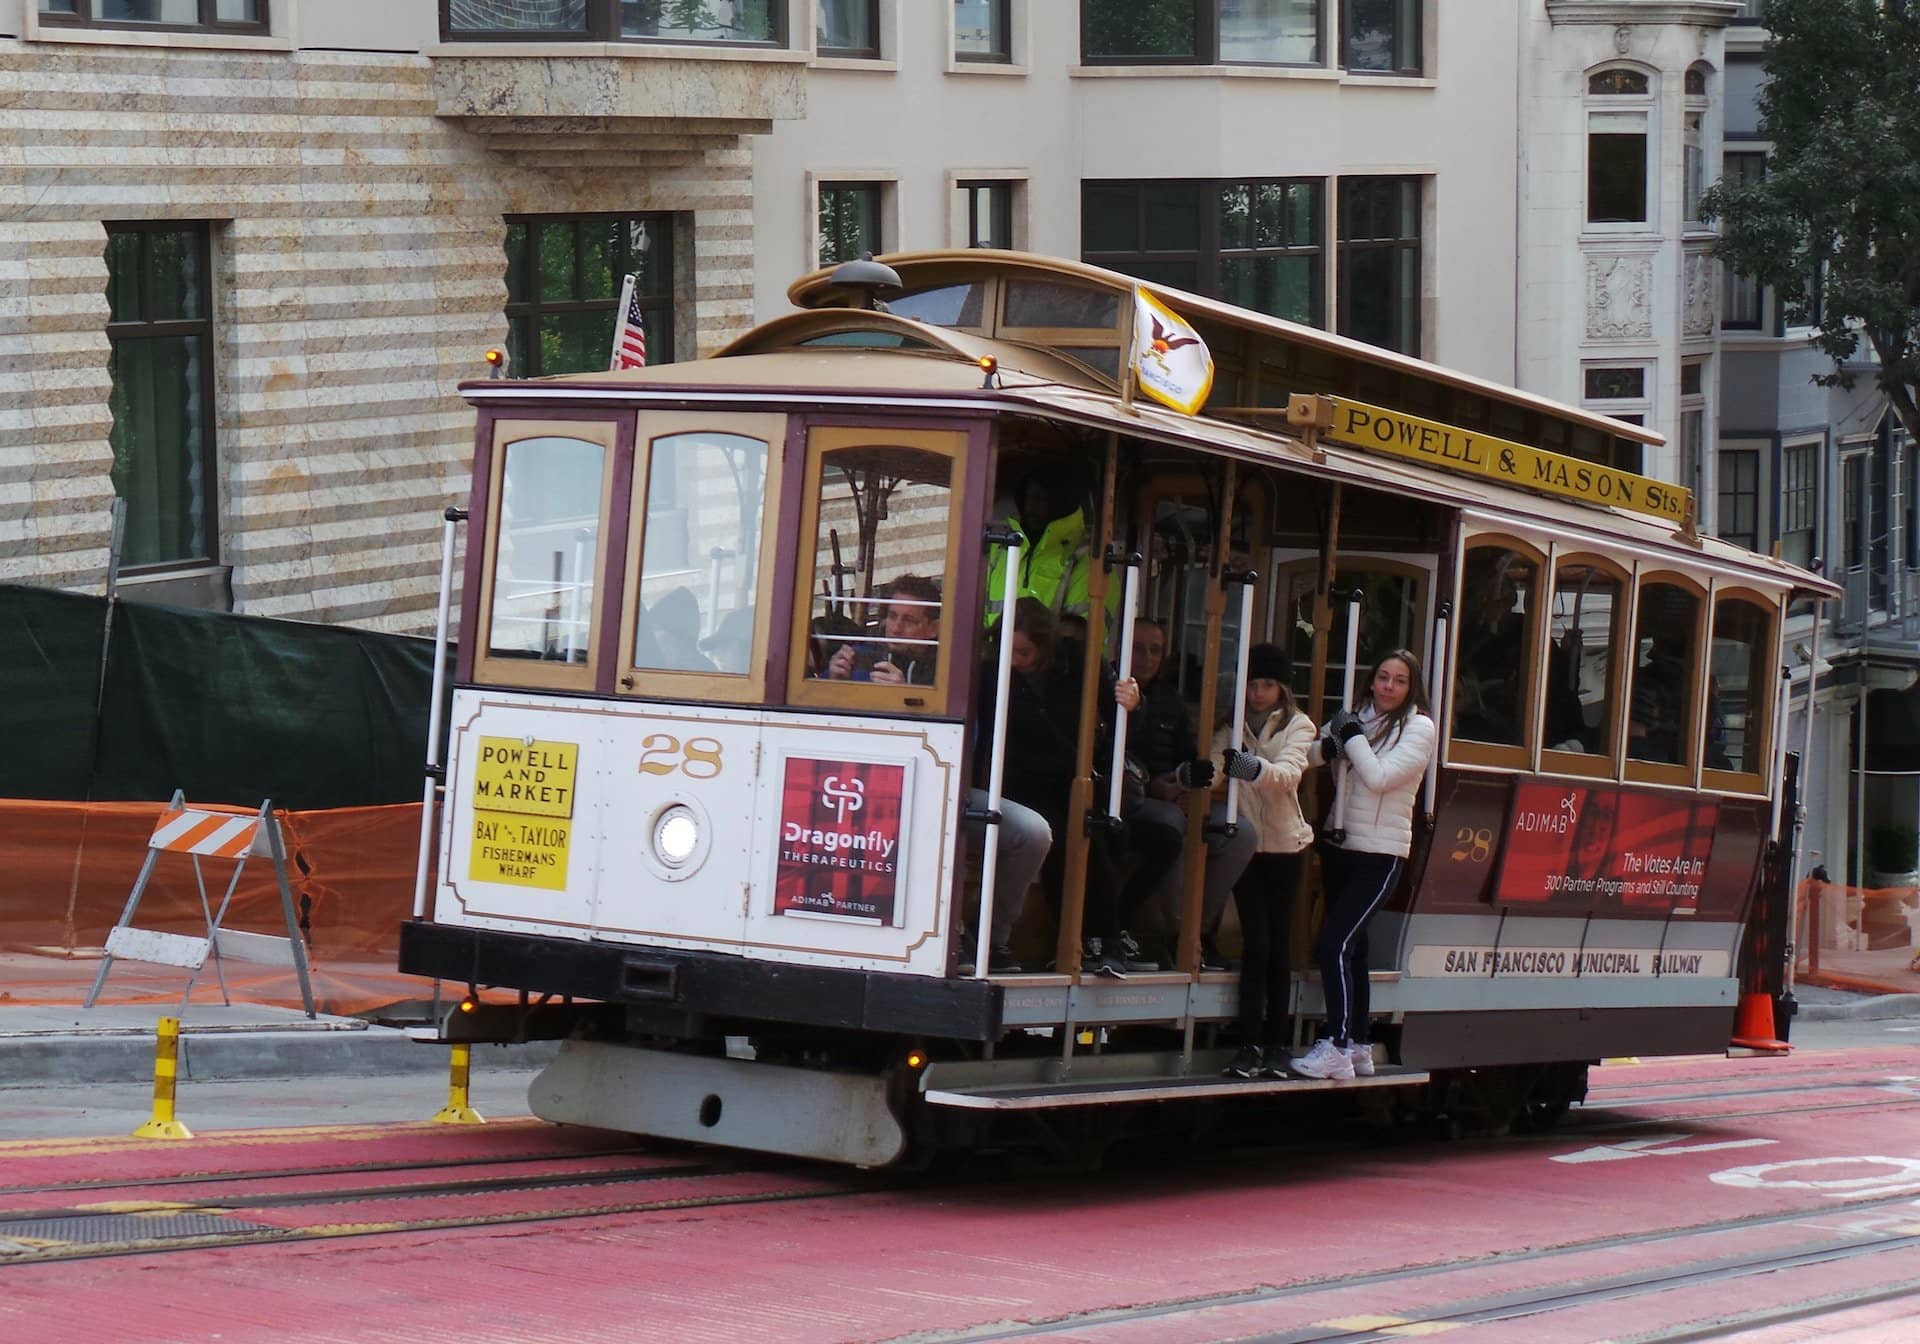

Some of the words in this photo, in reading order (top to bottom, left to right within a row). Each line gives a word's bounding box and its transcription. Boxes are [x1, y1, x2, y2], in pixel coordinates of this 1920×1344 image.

[1345, 408, 1482, 465] POWELL
[1498, 448, 1517, 476] &
[1533, 456, 1635, 502] MASON
[1645, 486, 1682, 515] Sts.
[482, 746, 568, 770] POWELL
[639, 733, 723, 779] 28
[504, 769, 545, 783] AND
[477, 780, 568, 804] MARKET
[476, 820, 499, 841] BAY
[520, 825, 567, 848] TAYLOR
[1516, 812, 1568, 834] ADIMAB
[785, 822, 895, 858] Dragonfly
[1451, 827, 1493, 863] 28
[482, 846, 556, 866] FISHERMANS
[783, 851, 893, 873] THERAPEUTICS
[1623, 852, 1641, 872] The
[1644, 853, 1671, 875] Votes
[1673, 856, 1689, 875] Are
[499, 863, 537, 879] WHARF
[1544, 875, 1562, 891] 300
[1562, 876, 1596, 892] Partner
[1596, 878, 1635, 897] Programs
[1635, 879, 1651, 894] and
[1651, 880, 1666, 895] Still
[1665, 881, 1699, 900] Counting
[791, 895, 829, 908] ADIMAB
[836, 900, 876, 913] PARTNER
[1444, 950, 1477, 973] SAN
